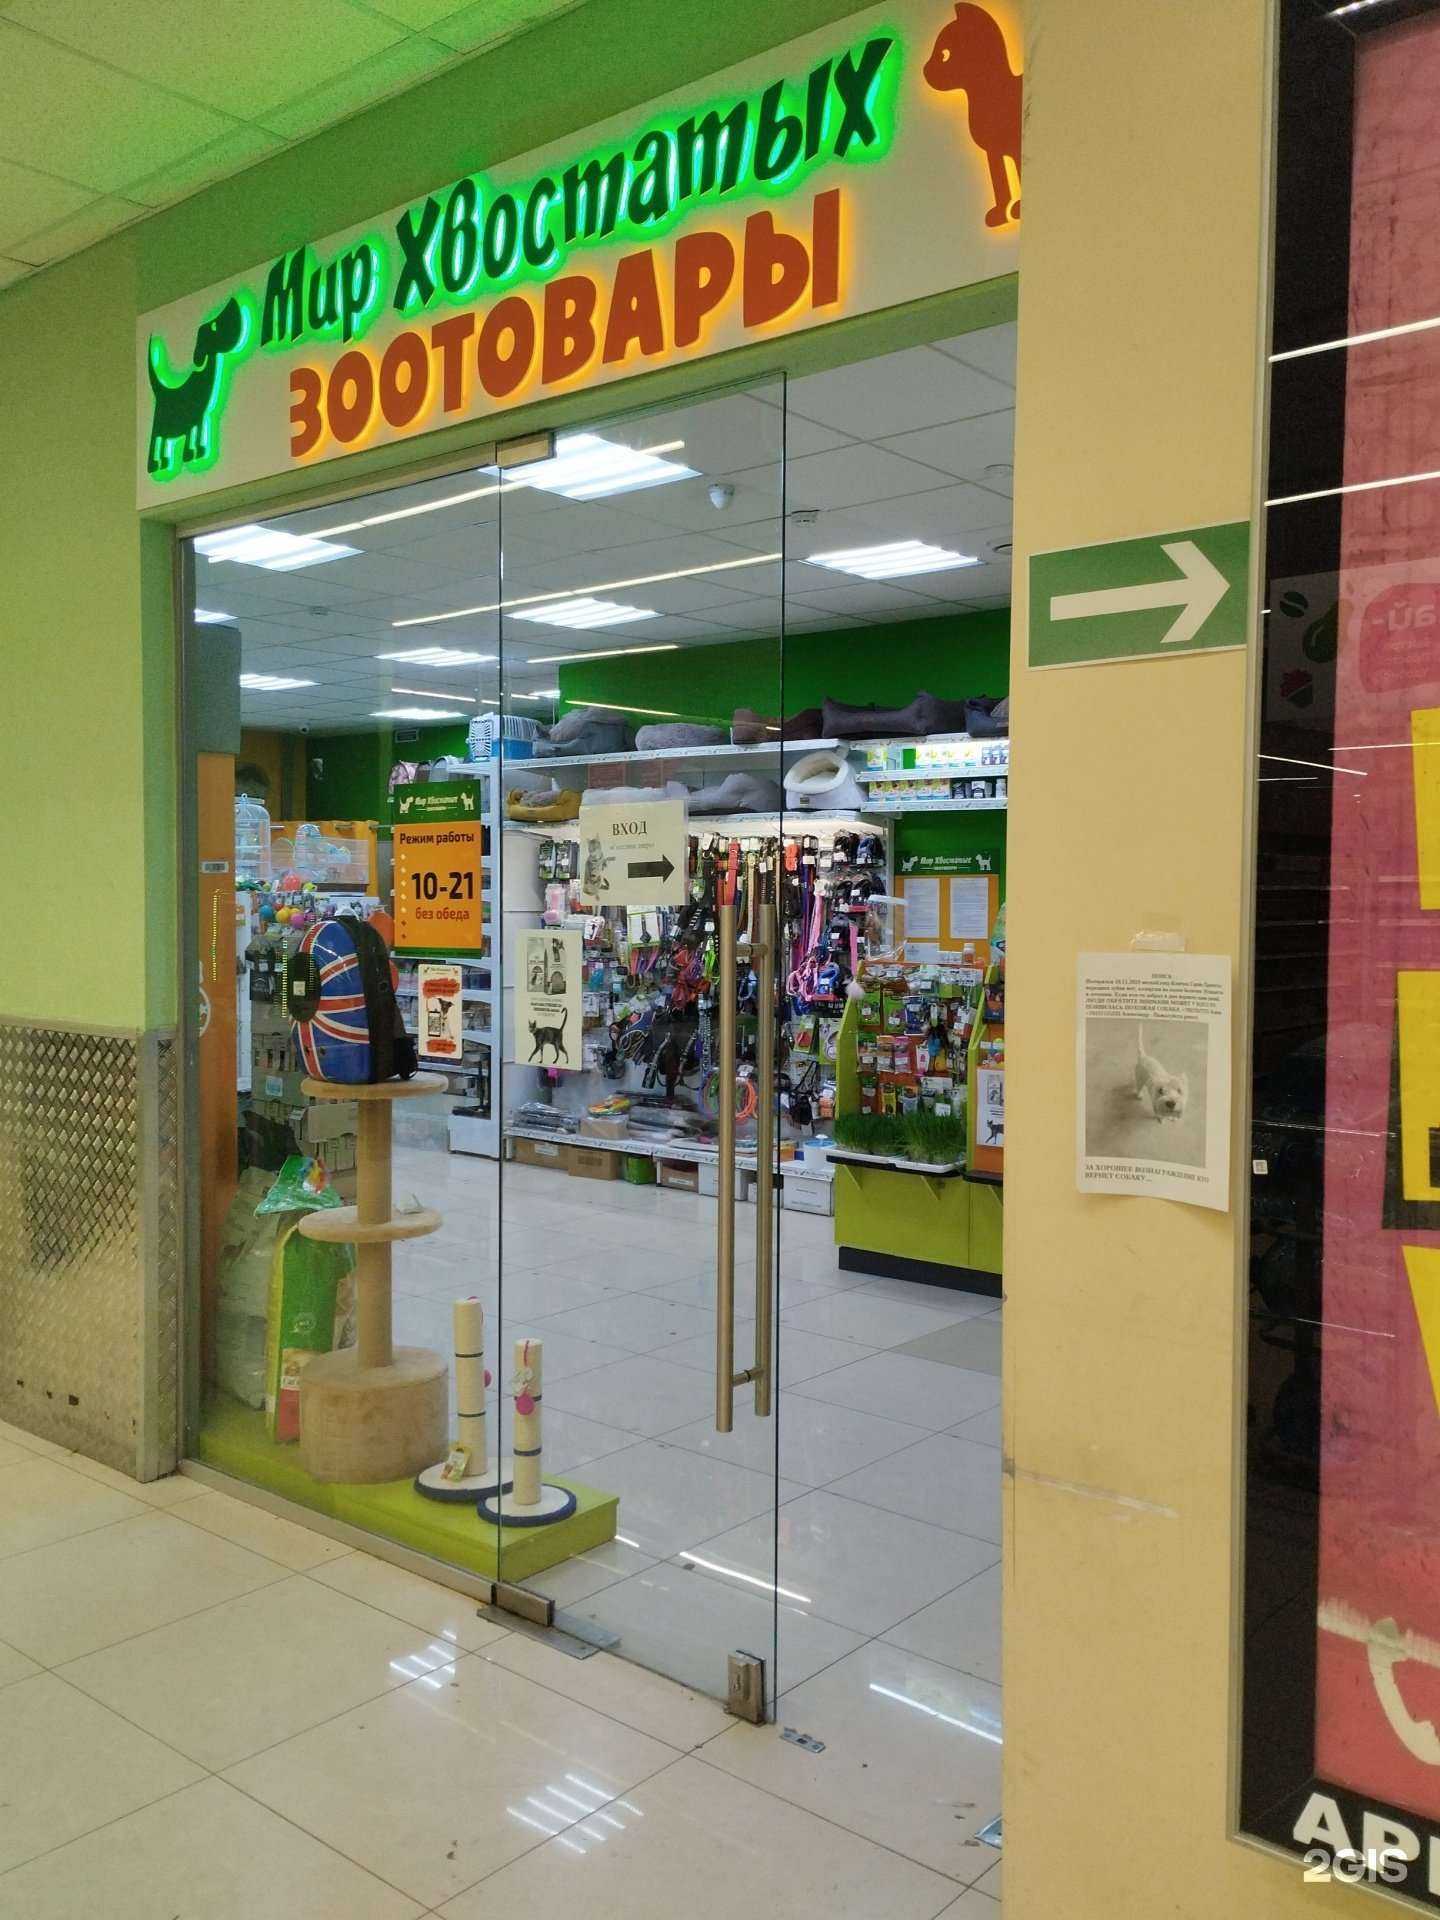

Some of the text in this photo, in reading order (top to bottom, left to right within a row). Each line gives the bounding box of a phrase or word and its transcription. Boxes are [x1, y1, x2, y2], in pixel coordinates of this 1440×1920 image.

[260, 36, 894, 346] Мир Хвостатых
[289, 188, 840, 458] ЗООТОВАРЫ
[400, 830, 475, 846] Режим работы
[612, 820, 648, 836] ВХОД
[411, 871, 474, 900] 10-21
[415, 906, 470, 920] без обеда
